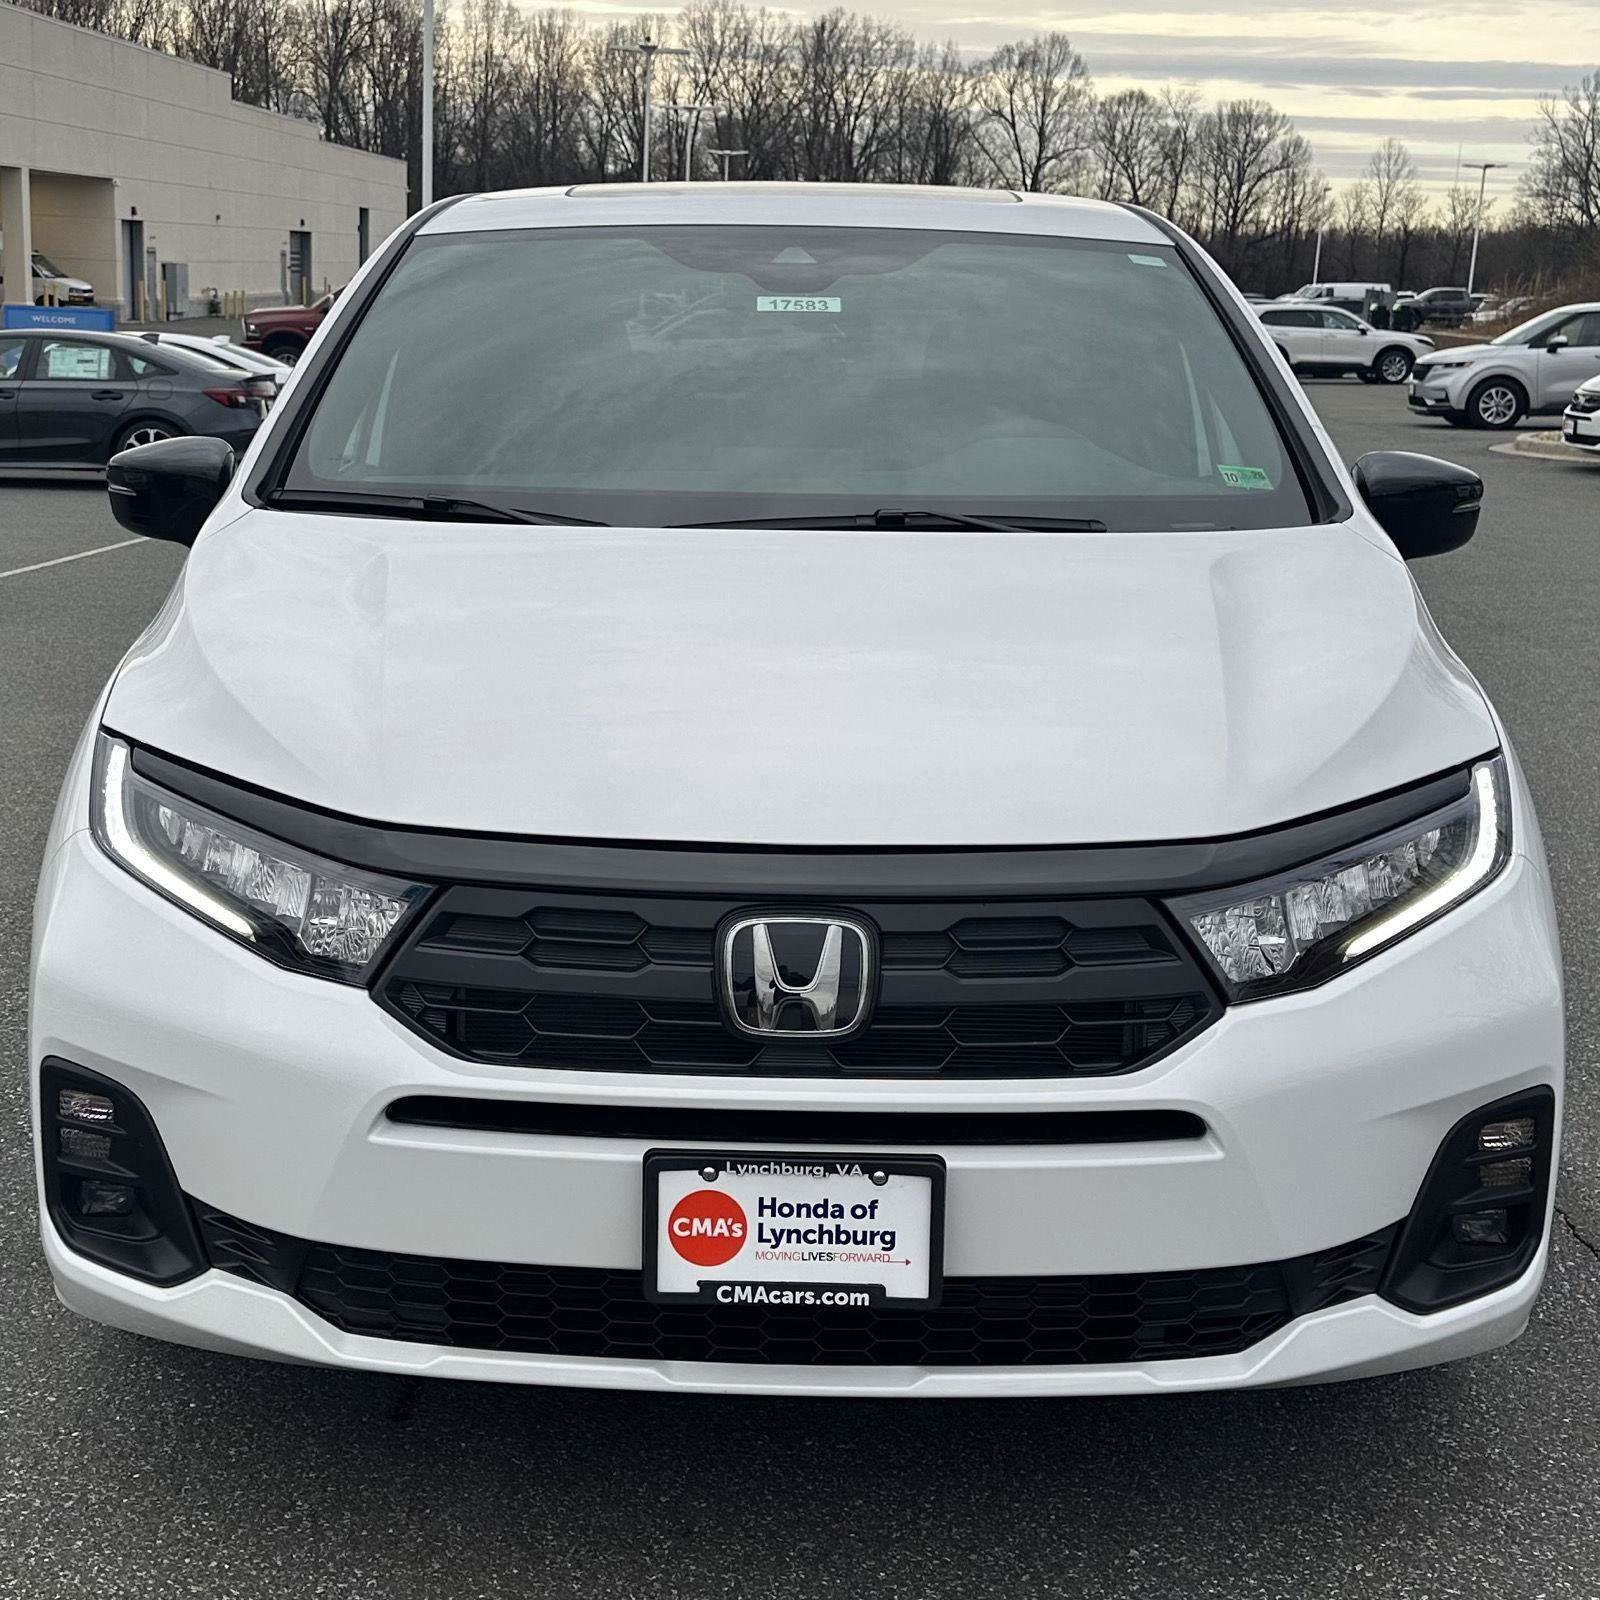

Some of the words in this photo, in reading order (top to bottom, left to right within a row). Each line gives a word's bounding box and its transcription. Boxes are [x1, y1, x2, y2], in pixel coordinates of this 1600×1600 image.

[768, 299, 829, 311] 17583
[32, 315, 77, 325] WELCOME
[1224, 472, 1239, 483] 10
[725, 1161, 830, 1179] Lynchburg,
[835, 1163, 863, 1177] VA
[757, 1197, 845, 1220] Honda
[850, 1199, 879, 1220] of
[672, 1218, 743, 1238] CMA's
[757, 1222, 896, 1250] Lynchburg
[716, 1285, 870, 1306] CMAcars.com
